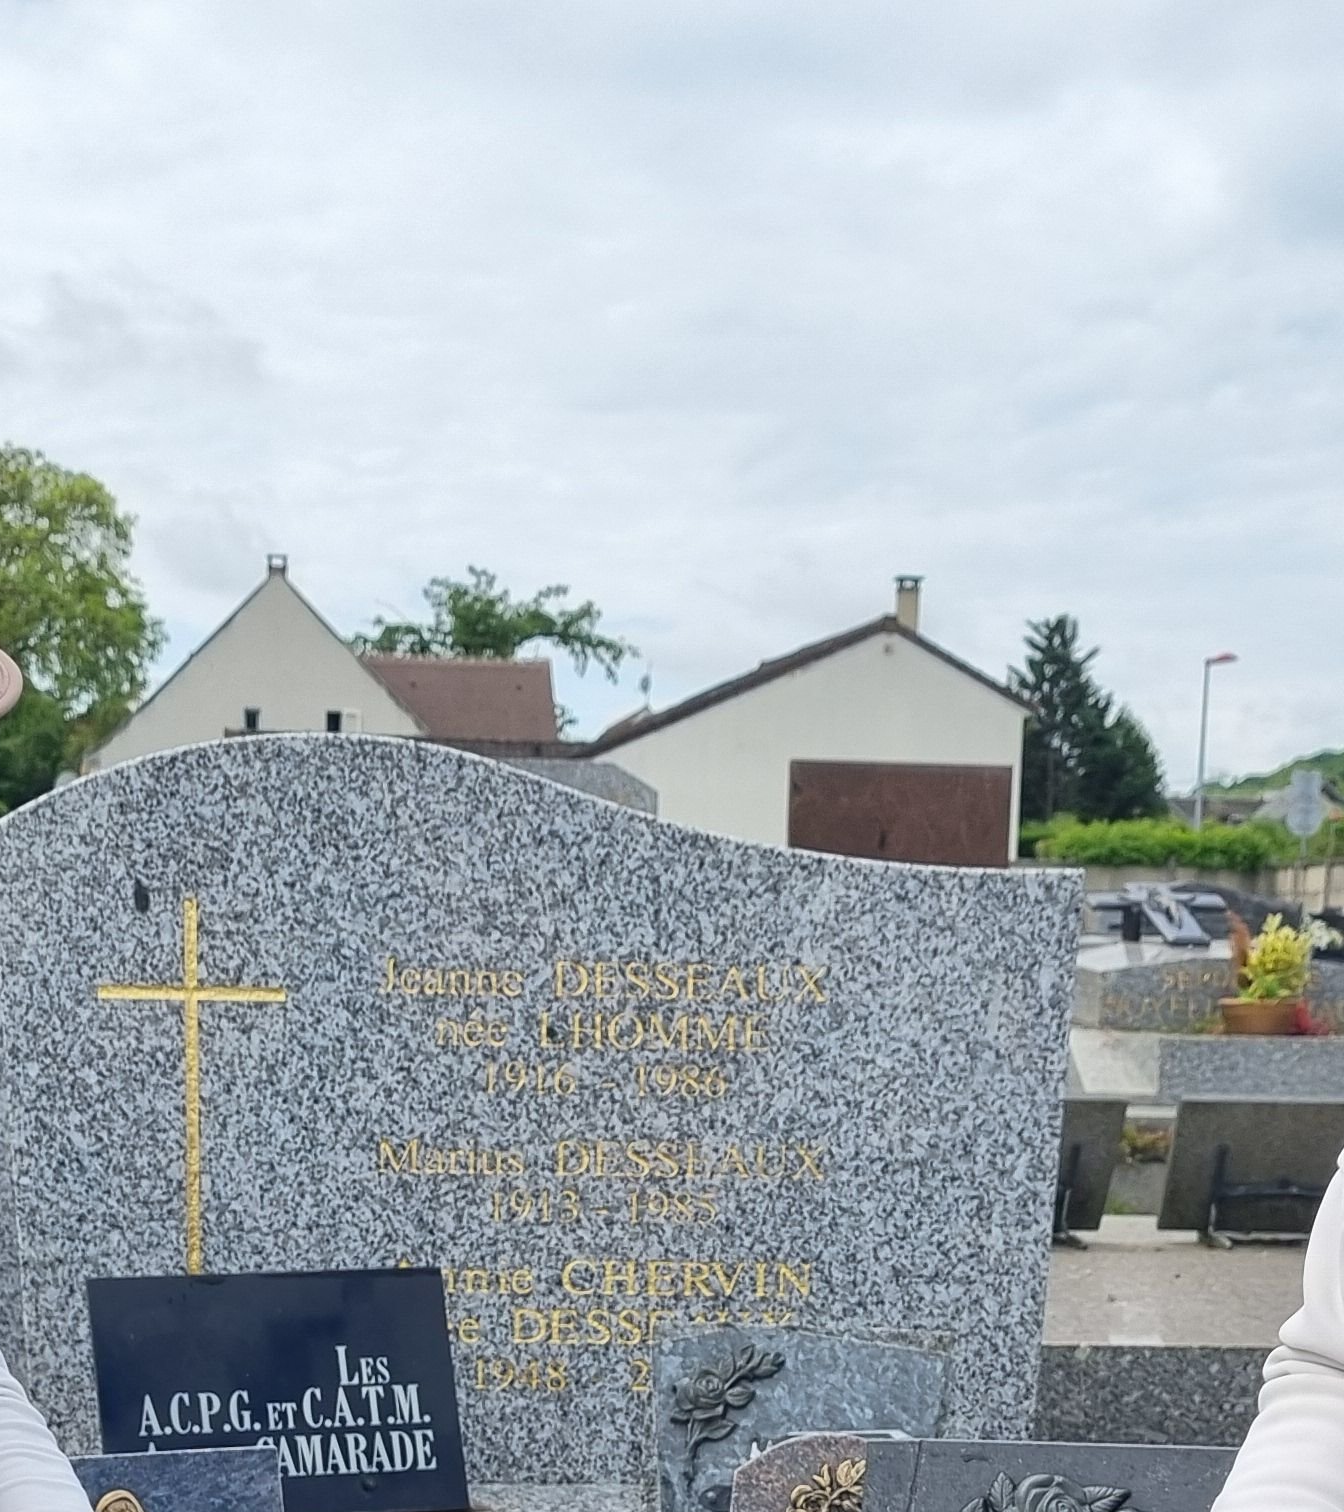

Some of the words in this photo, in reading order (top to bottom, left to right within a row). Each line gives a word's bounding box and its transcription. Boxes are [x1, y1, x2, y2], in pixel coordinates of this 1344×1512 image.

[379, 956, 526, 998] Jeanne
[555, 959, 832, 1004] DESSEAUX
[539, 1011, 770, 1052] LHOMME
[485, 1062, 578, 1097] 1916
[636, 1063, 729, 1099] 1986
[377, 1137, 526, 1176] Marius
[555, 1140, 826, 1181] DESSEAUX
[560, 1258, 812, 1298] CHERVIN
[138, 1389, 262, 1437] A.C.P.G.
[266, 1401, 298, 1431] ET
[302, 1383, 432, 1430] C.A.T.M.
[257, 1428, 438, 1478] AMARADE
